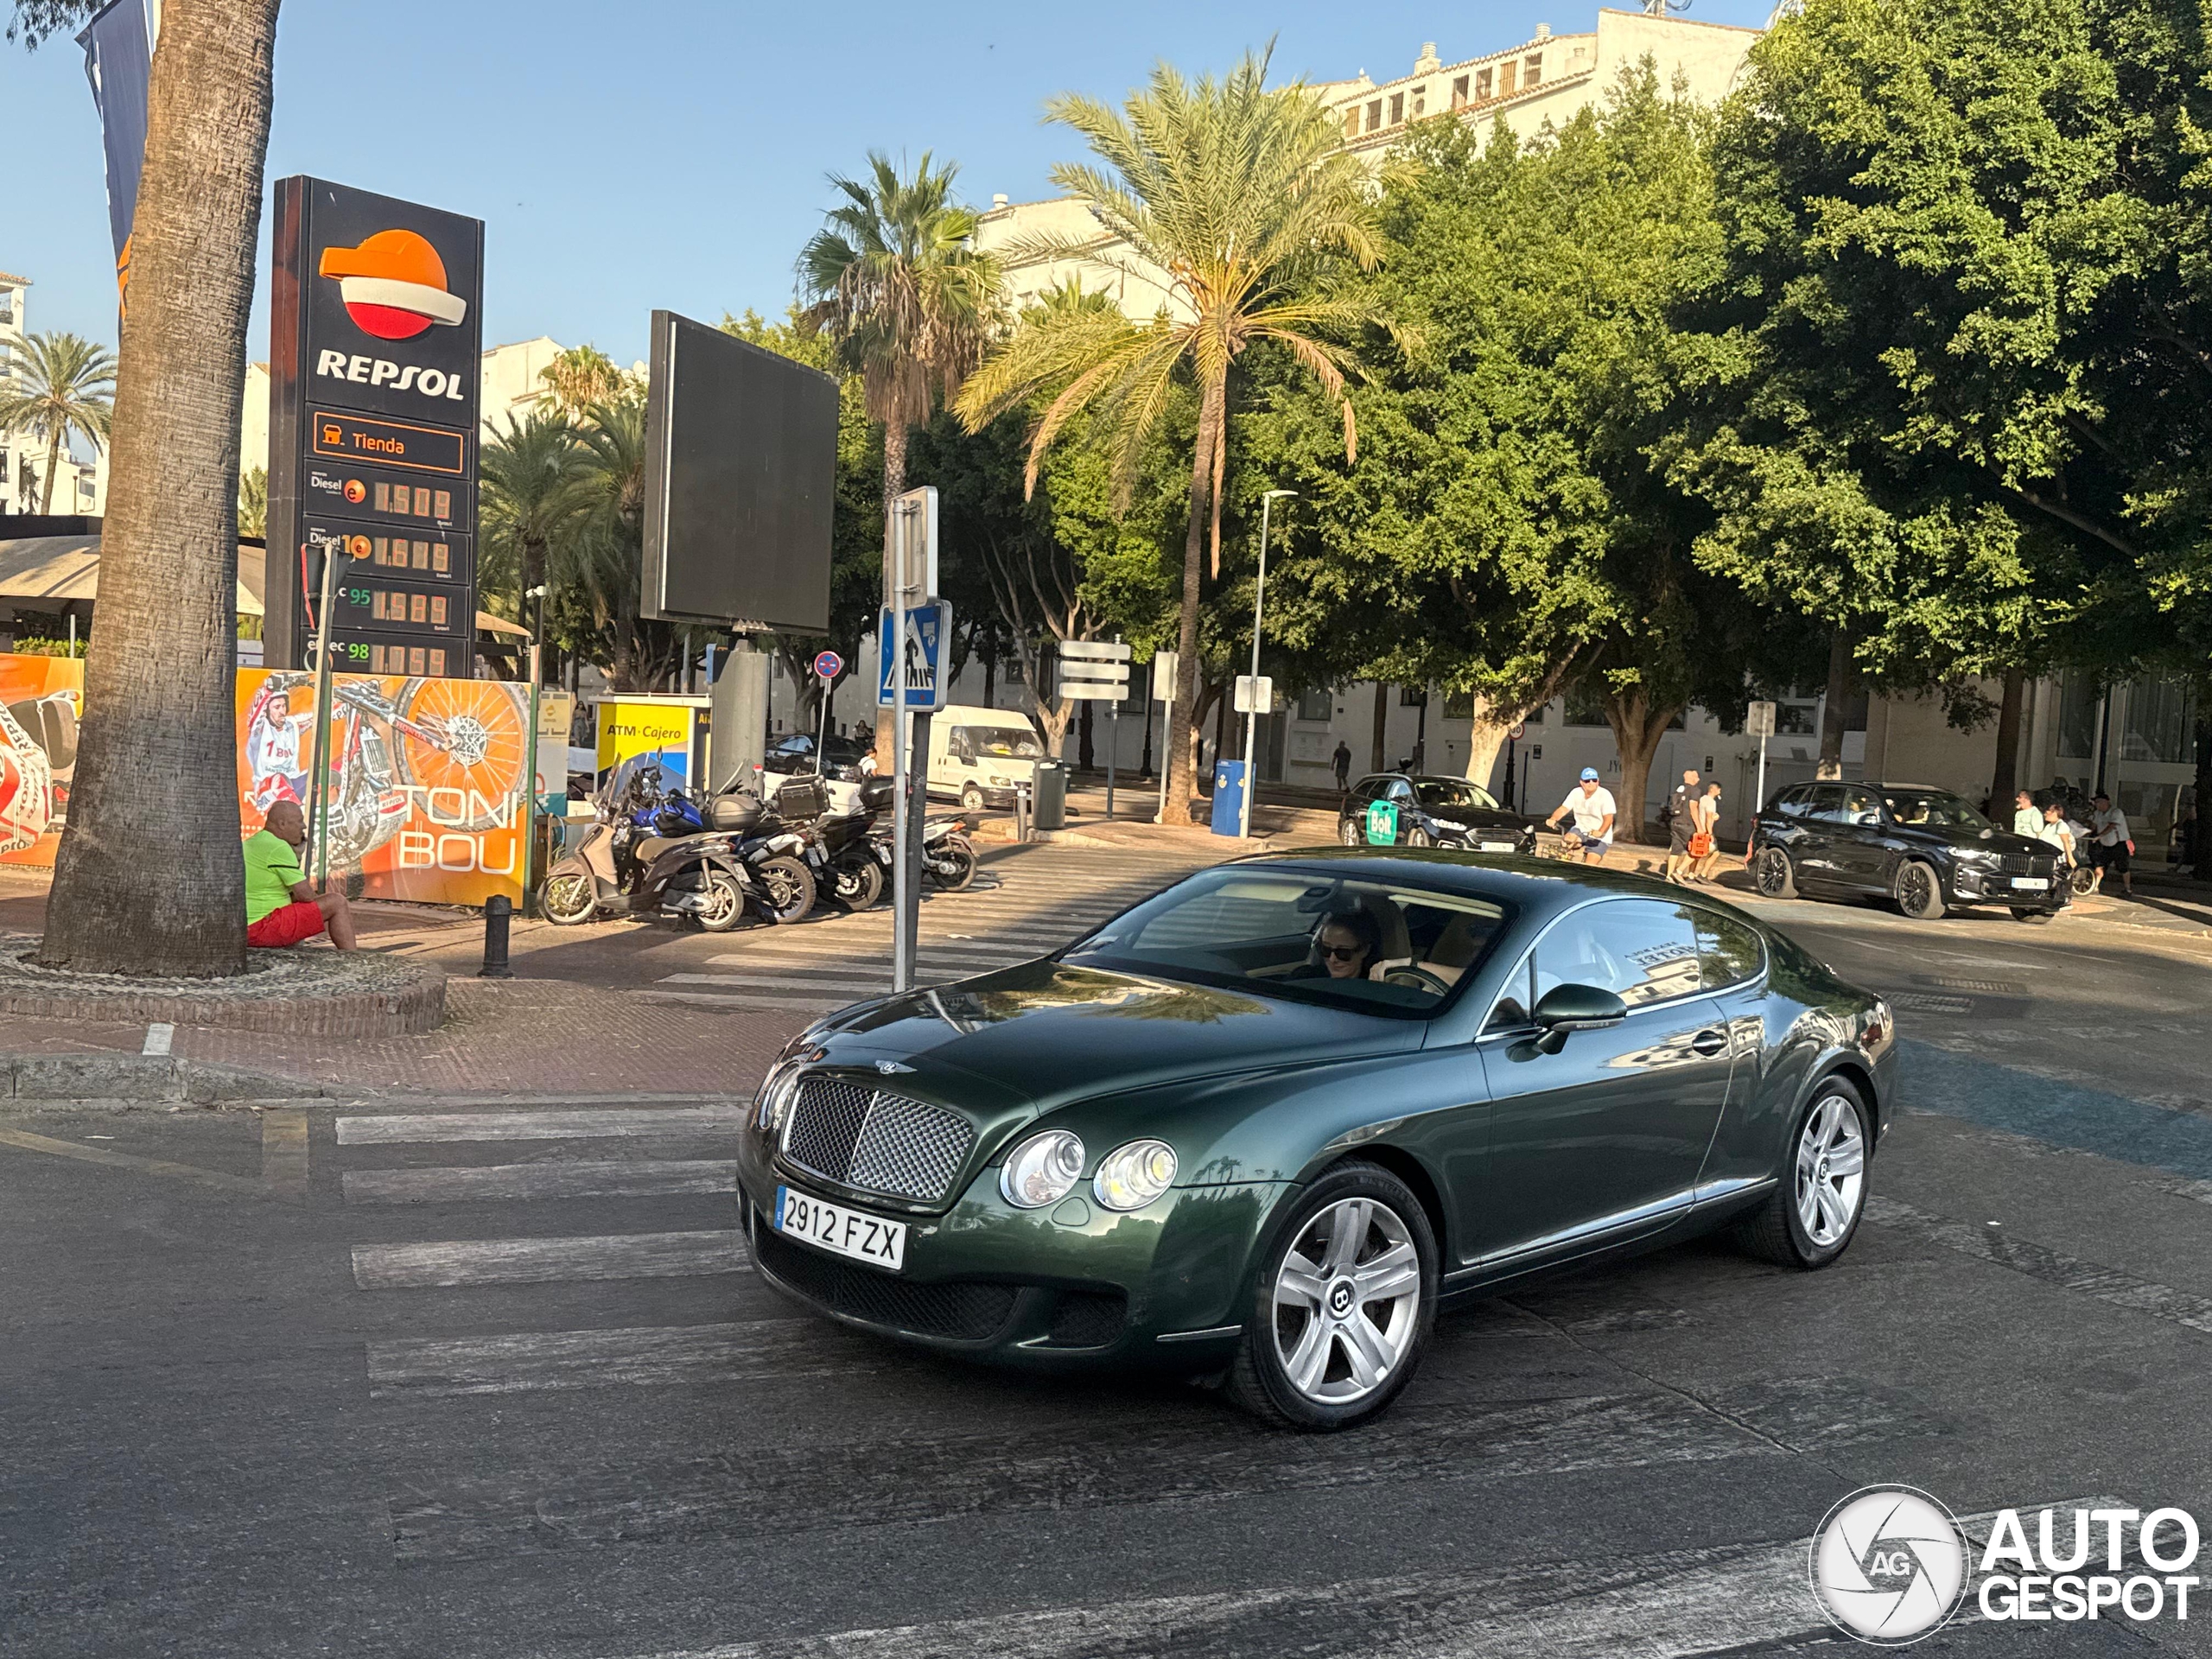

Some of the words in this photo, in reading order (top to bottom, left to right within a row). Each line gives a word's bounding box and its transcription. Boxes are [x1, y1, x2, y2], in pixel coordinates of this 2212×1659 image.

[317, 349, 464, 401] REPSOL
[353, 432, 405, 454] Tienda
[311, 475, 342, 491] Diesel
[375, 482, 450, 519] 1.509
[309, 531, 340, 546] Diesel
[350, 588, 371, 605] 95
[348, 644, 370, 659] 98
[607, 724, 636, 737] ATM
[642, 726, 681, 741] Cajero
[394, 784, 518, 830] TONI
[1371, 810, 1392, 836] Bolt
[399, 821, 516, 875] BOU
[785, 1195, 837, 1243] 2912
[844, 1215, 898, 1261] FZX
